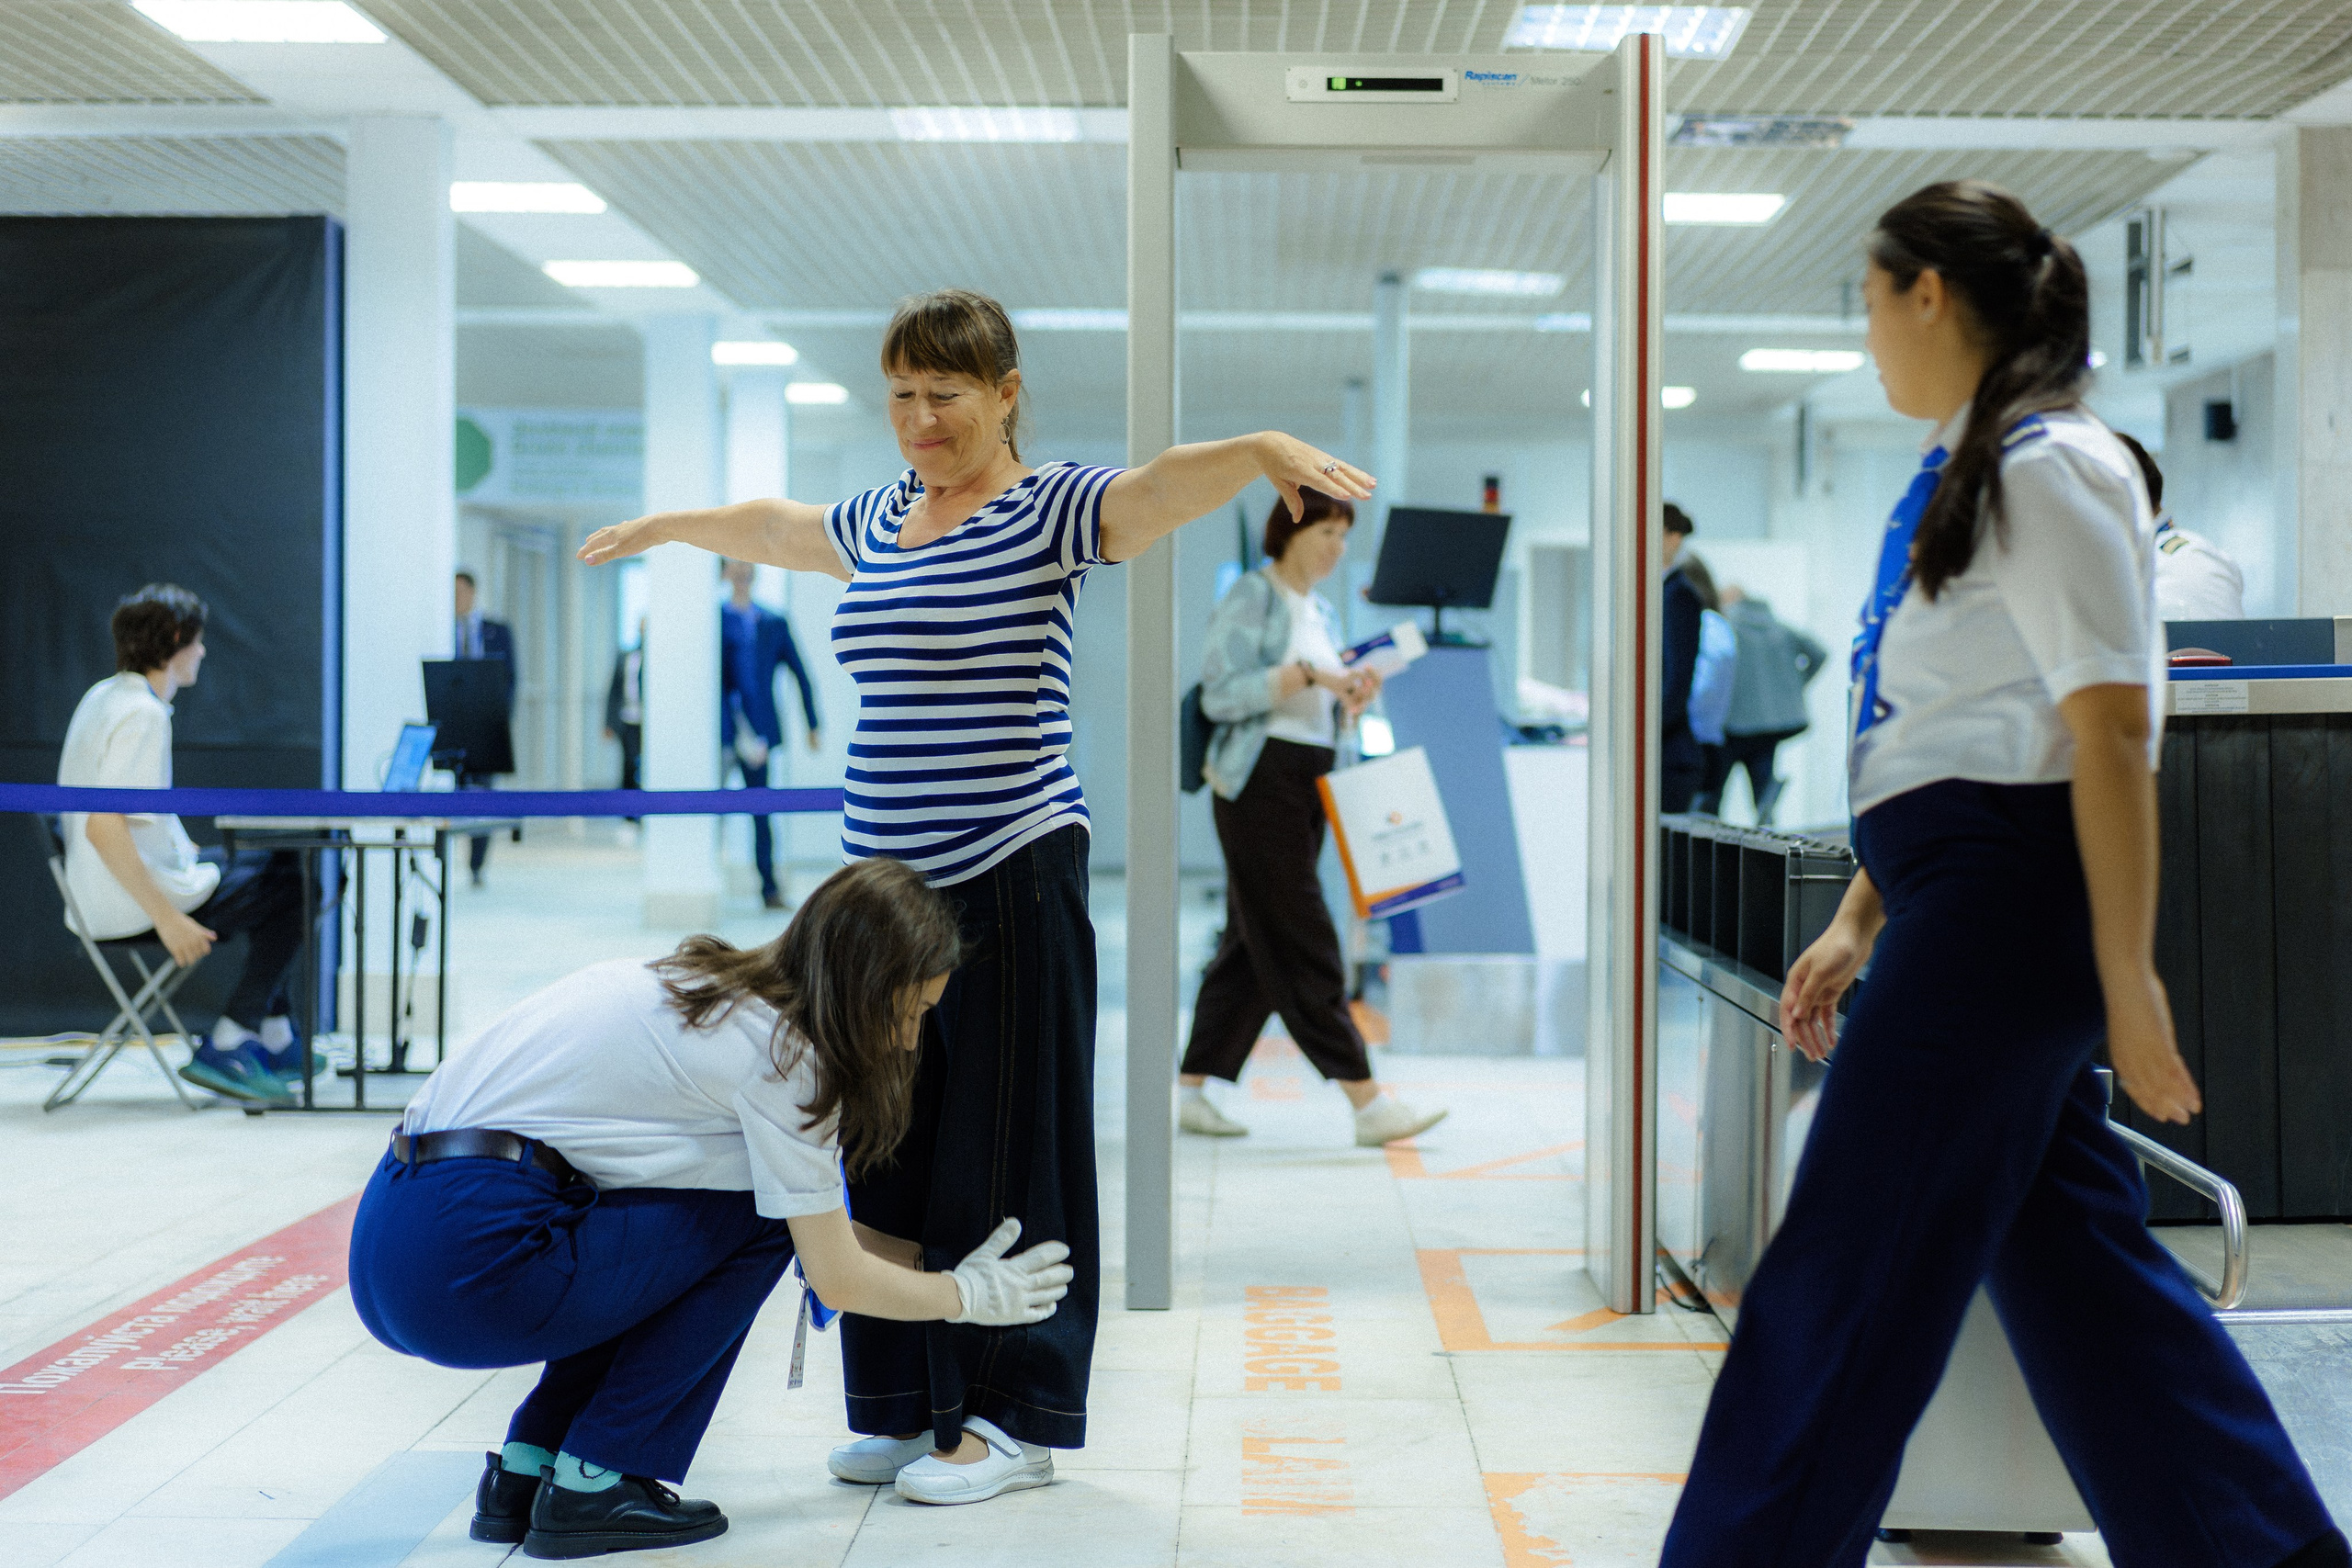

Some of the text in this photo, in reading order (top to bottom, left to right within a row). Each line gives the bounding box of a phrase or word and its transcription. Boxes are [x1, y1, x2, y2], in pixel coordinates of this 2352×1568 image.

[1464, 71, 1517, 82] Rapiscan
[0, 1314, 180, 1394] Пожалуйста
[1244, 1285, 1342, 1392] BAGGAGE
